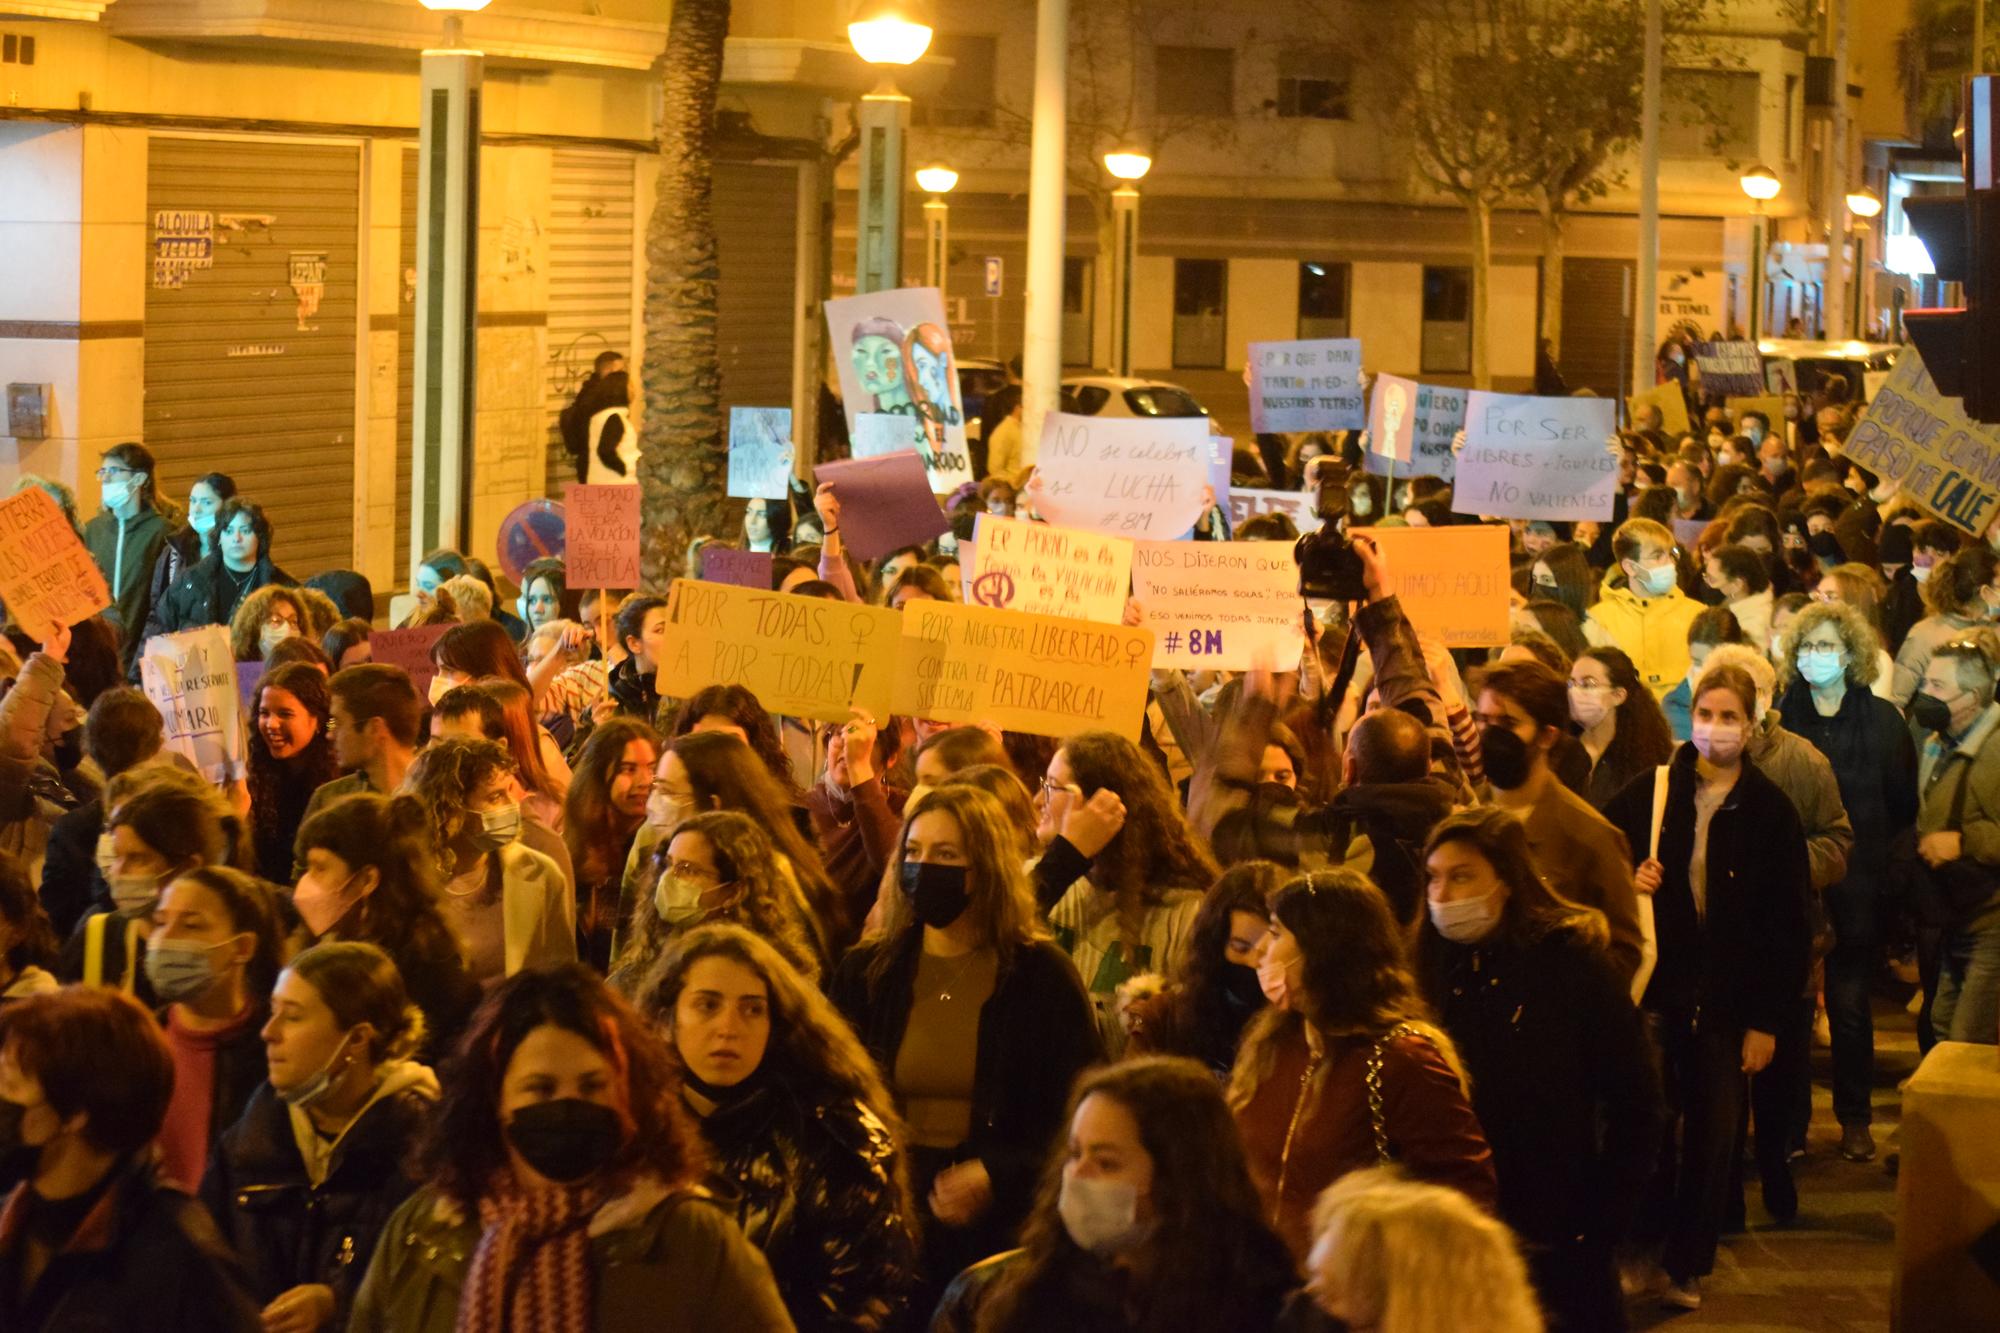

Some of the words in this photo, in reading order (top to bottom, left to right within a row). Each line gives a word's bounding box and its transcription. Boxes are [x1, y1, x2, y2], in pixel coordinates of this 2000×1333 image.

[157, 213, 210, 234] ALQUILA
[1054, 425, 1090, 458] NO
[1104, 472, 1182, 504] LUCHA
[1489, 480, 1519, 504] NO
[1138, 550, 1175, 567] NOS
[1256, 558, 1290, 572] QUE
[920, 612, 954, 645] POR
[963, 619, 1026, 650] NUESTRA
[673, 640, 691, 676] A
[713, 640, 759, 686] POR
[917, 656, 969, 682] CONTRA
[975, 663, 989, 684] EL
[917, 682, 975, 712] SISTEMA
[991, 668, 1105, 719] PATRIARCAL
